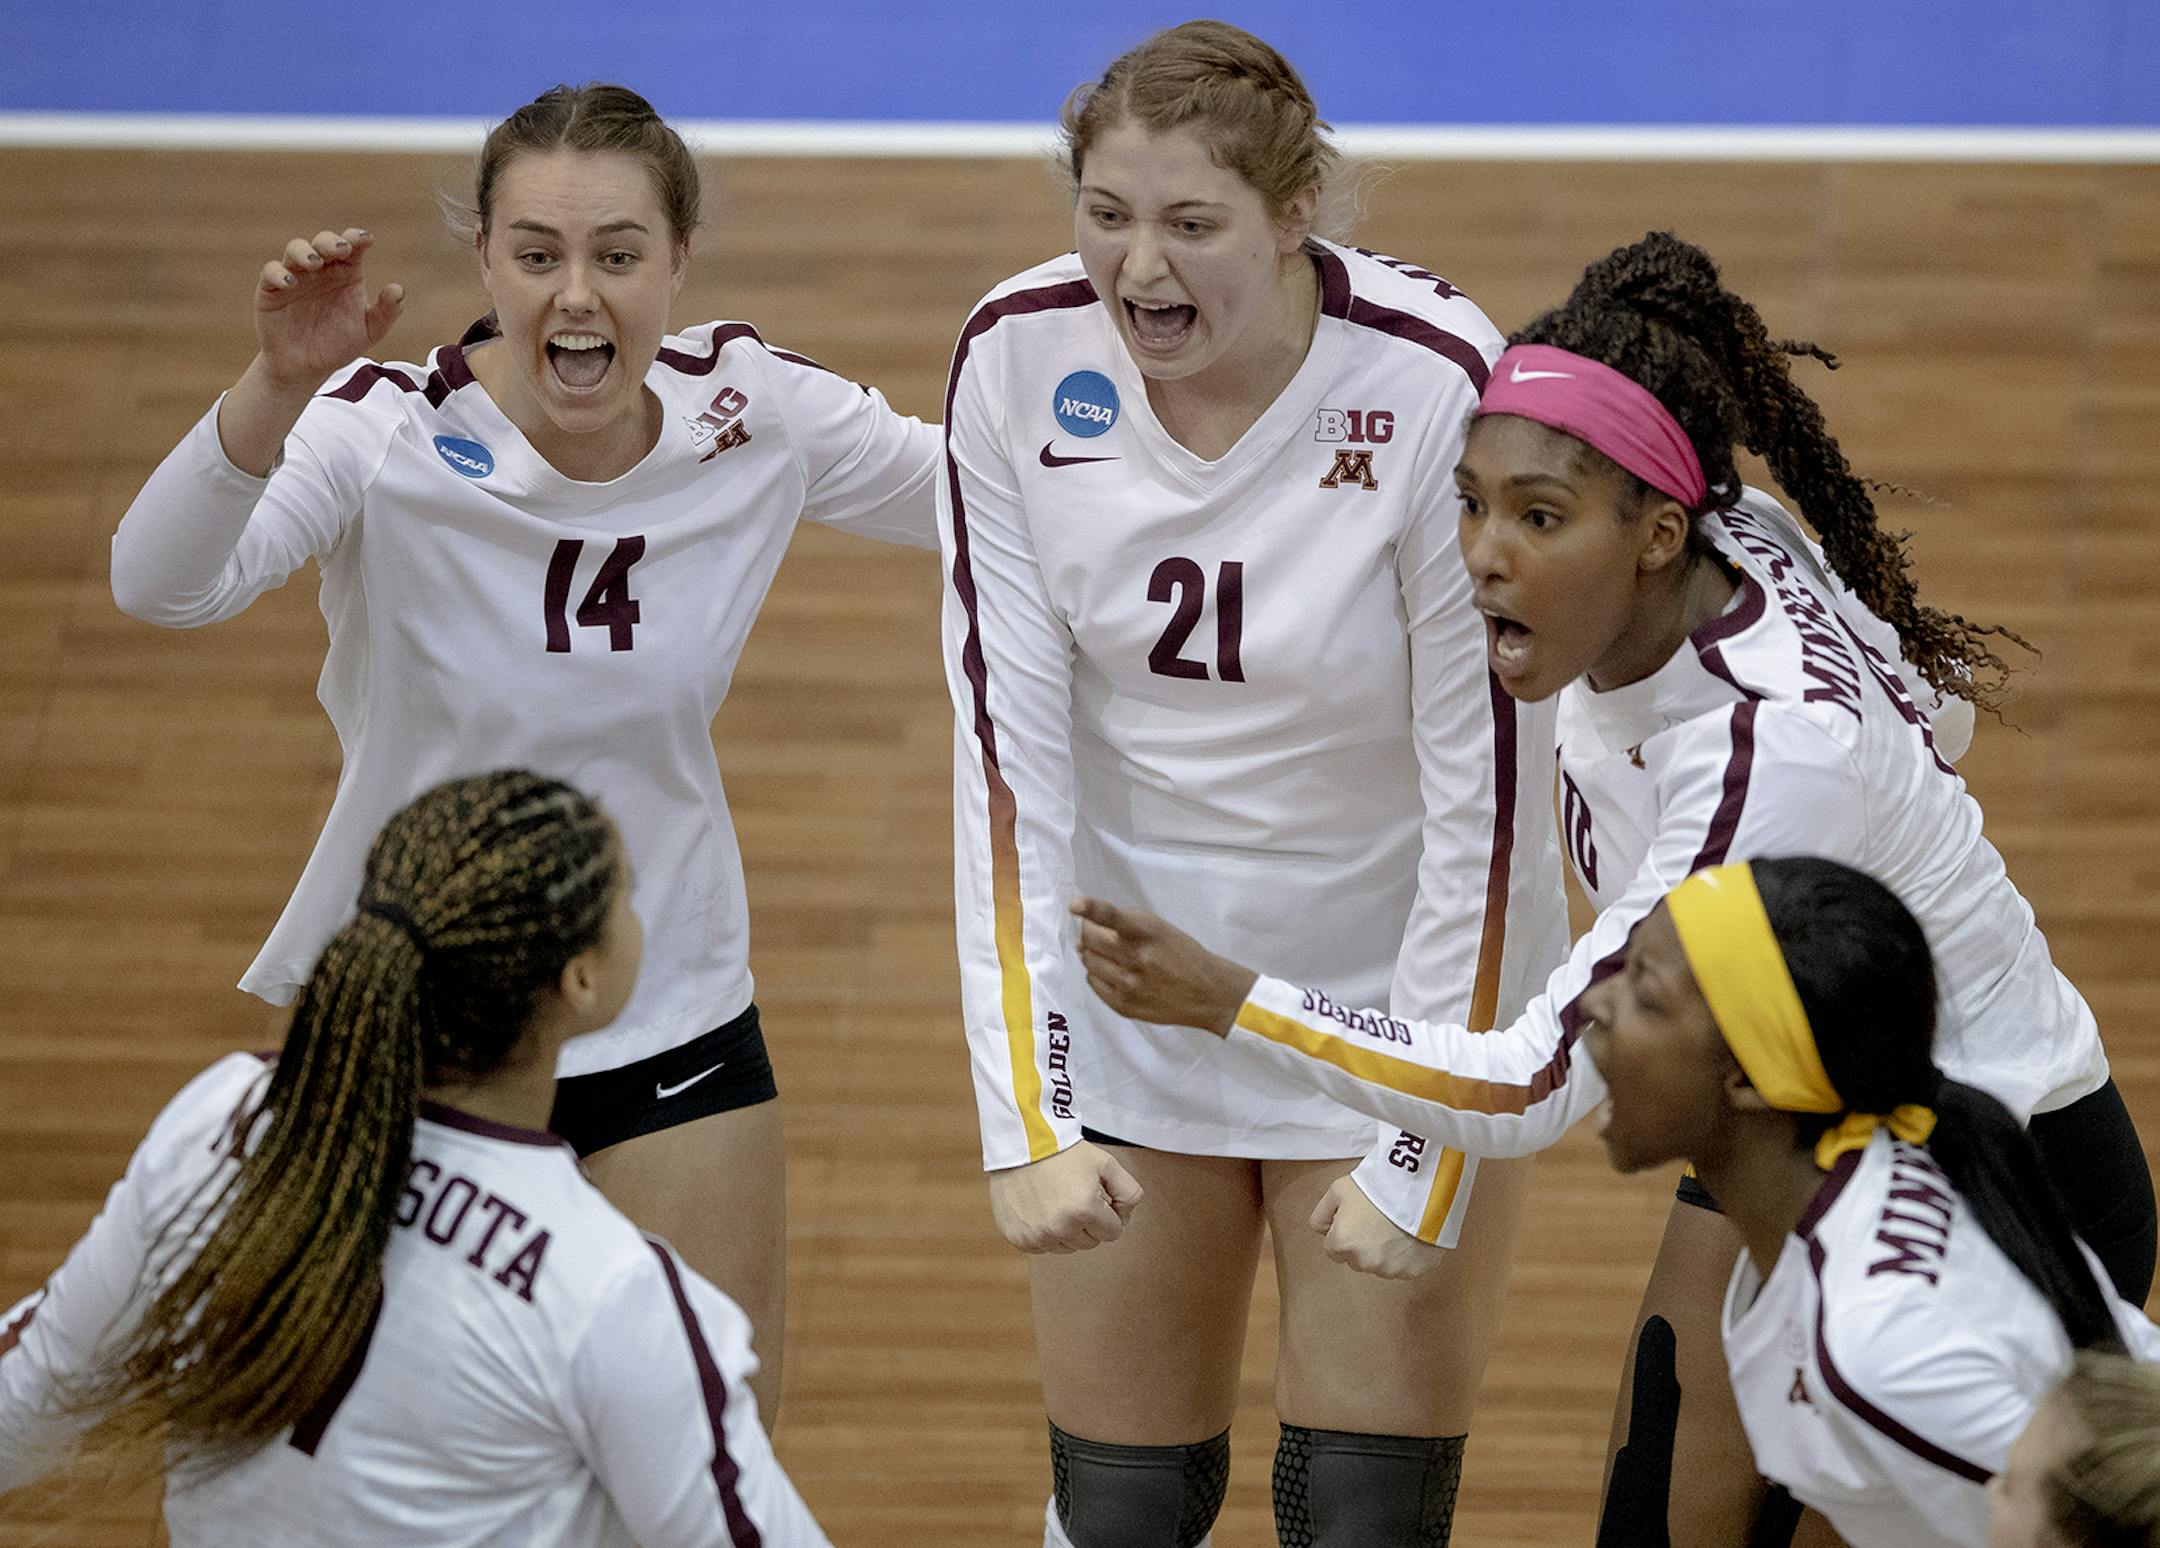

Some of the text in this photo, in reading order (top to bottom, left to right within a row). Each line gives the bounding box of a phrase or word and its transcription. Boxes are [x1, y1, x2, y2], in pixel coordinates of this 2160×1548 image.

[1059, 398, 1115, 426] NCAA
[440, 445, 489, 473] NCAA
[1319, 449, 1378, 490] M
[544, 535, 646, 653] 14
[1147, 556, 1246, 683] 21
[1048, 1011, 1076, 1119] GOLDEN
[1389, 1130, 1427, 1174] RS
